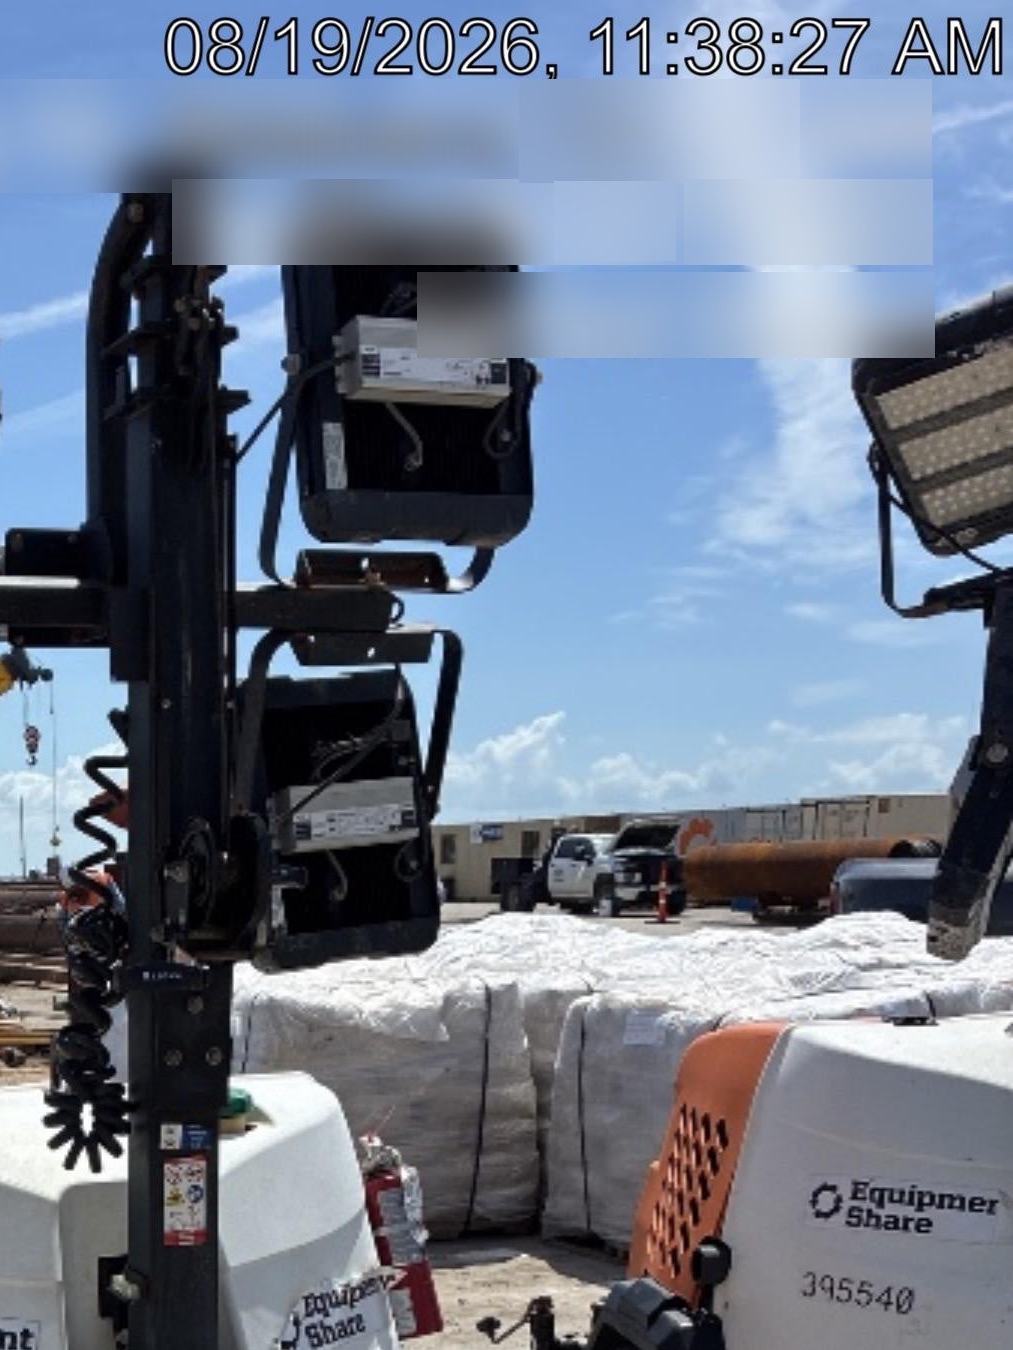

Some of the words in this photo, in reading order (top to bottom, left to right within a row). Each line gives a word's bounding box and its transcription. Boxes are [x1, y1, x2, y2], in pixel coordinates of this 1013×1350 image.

[845, 1206, 933, 1234] Share
[802, 1271, 915, 1314] 395540
[304, 1314, 366, 1349] Share
